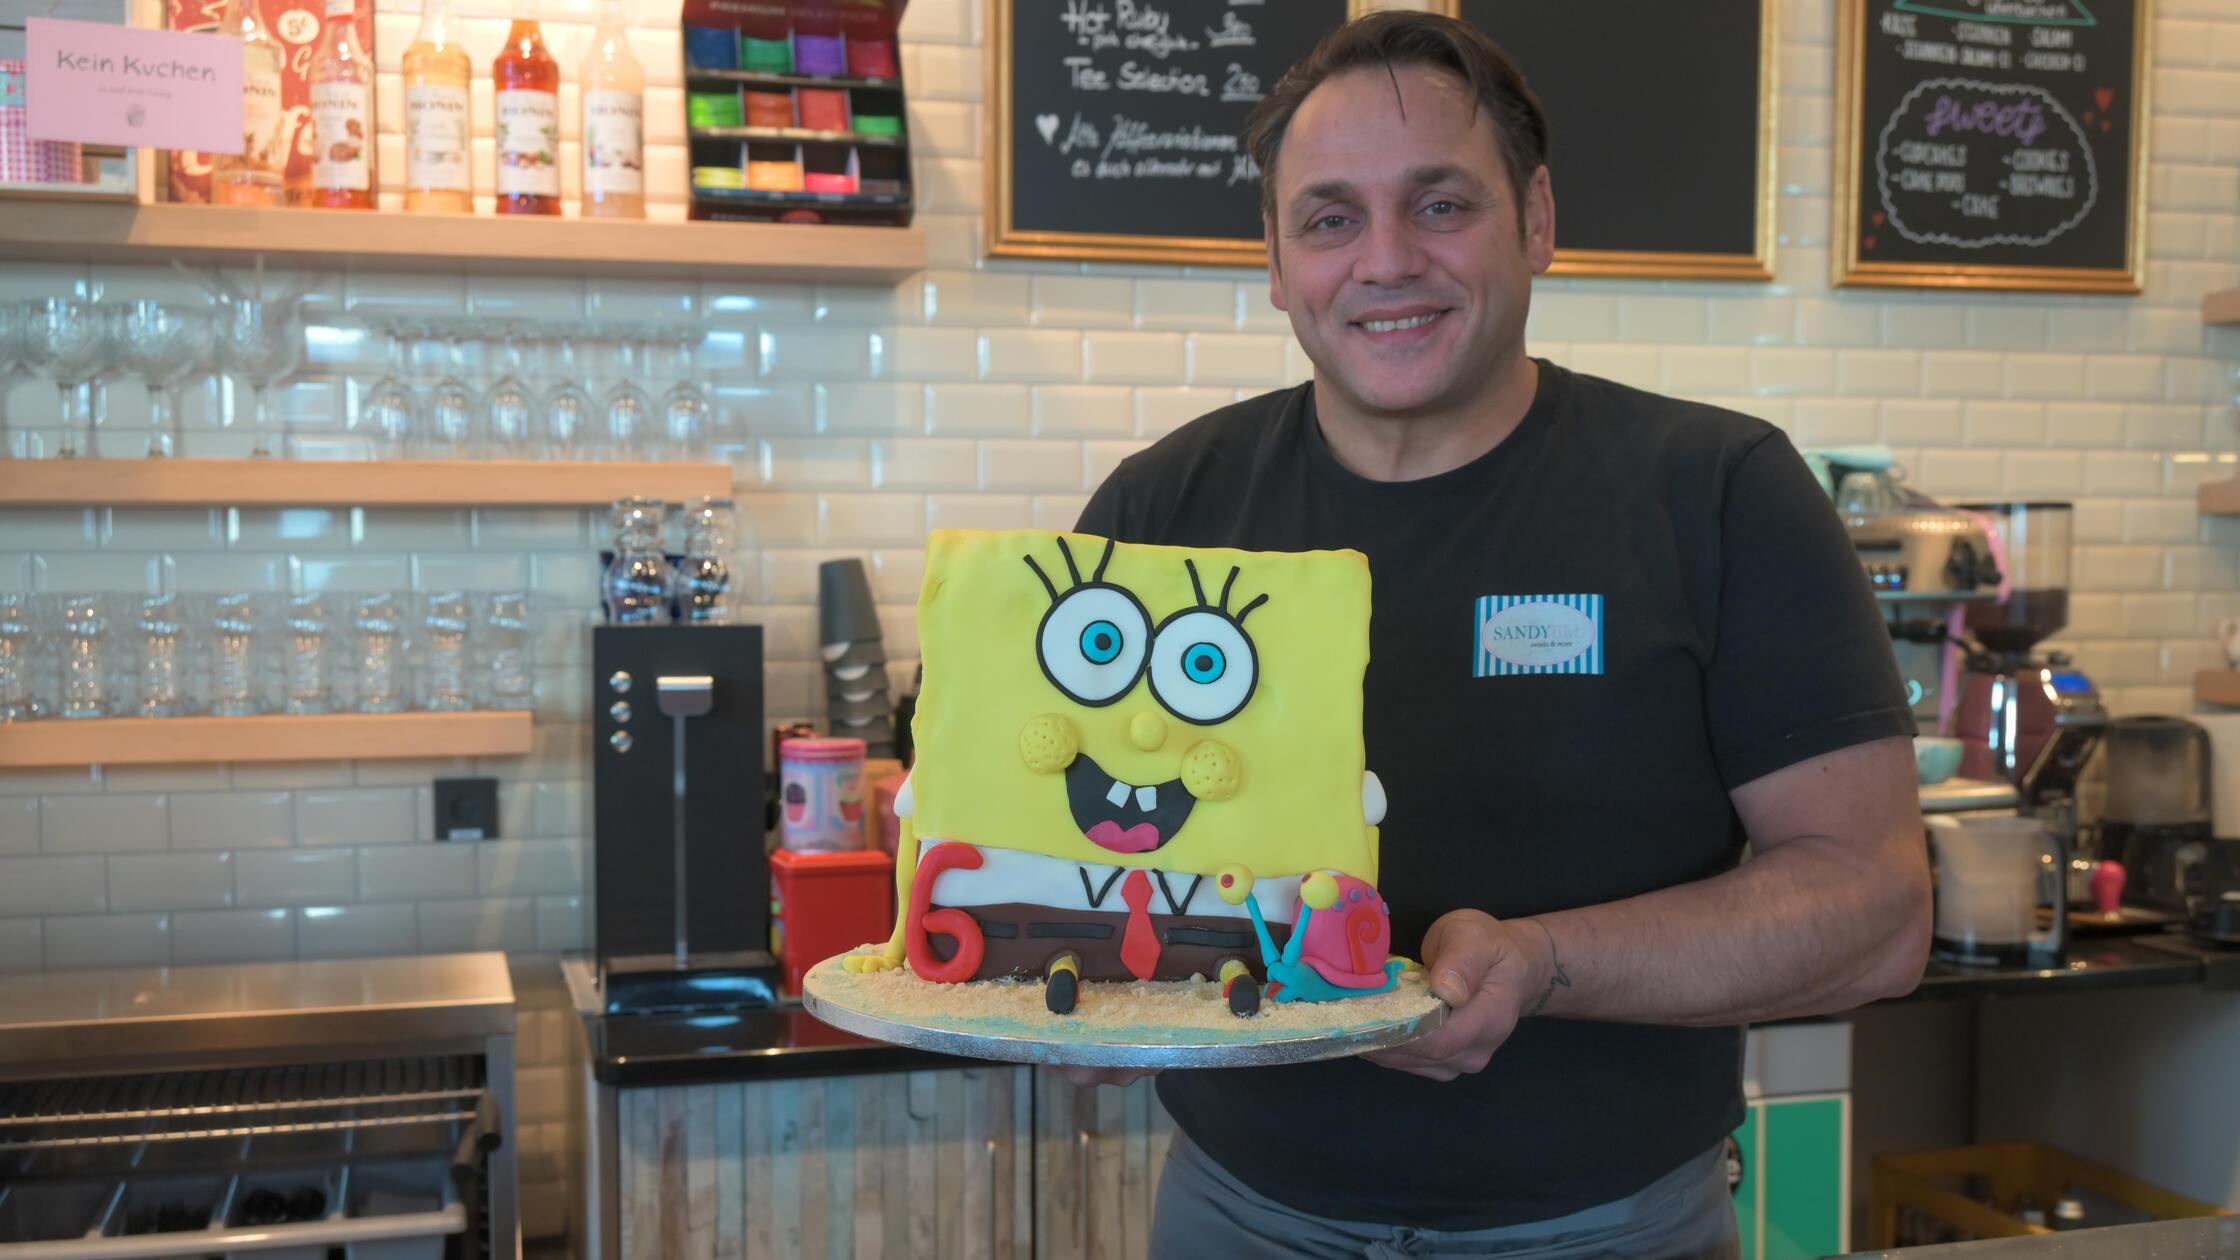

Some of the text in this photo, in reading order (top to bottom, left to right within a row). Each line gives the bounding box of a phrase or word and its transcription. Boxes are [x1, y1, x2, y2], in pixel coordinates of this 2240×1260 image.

[57, 49, 217, 83] Kein Kuchen
[1063, 58, 1111, 90] Tee
[1116, 60, 1211, 97] Selection
[905, 841, 984, 983] 6
